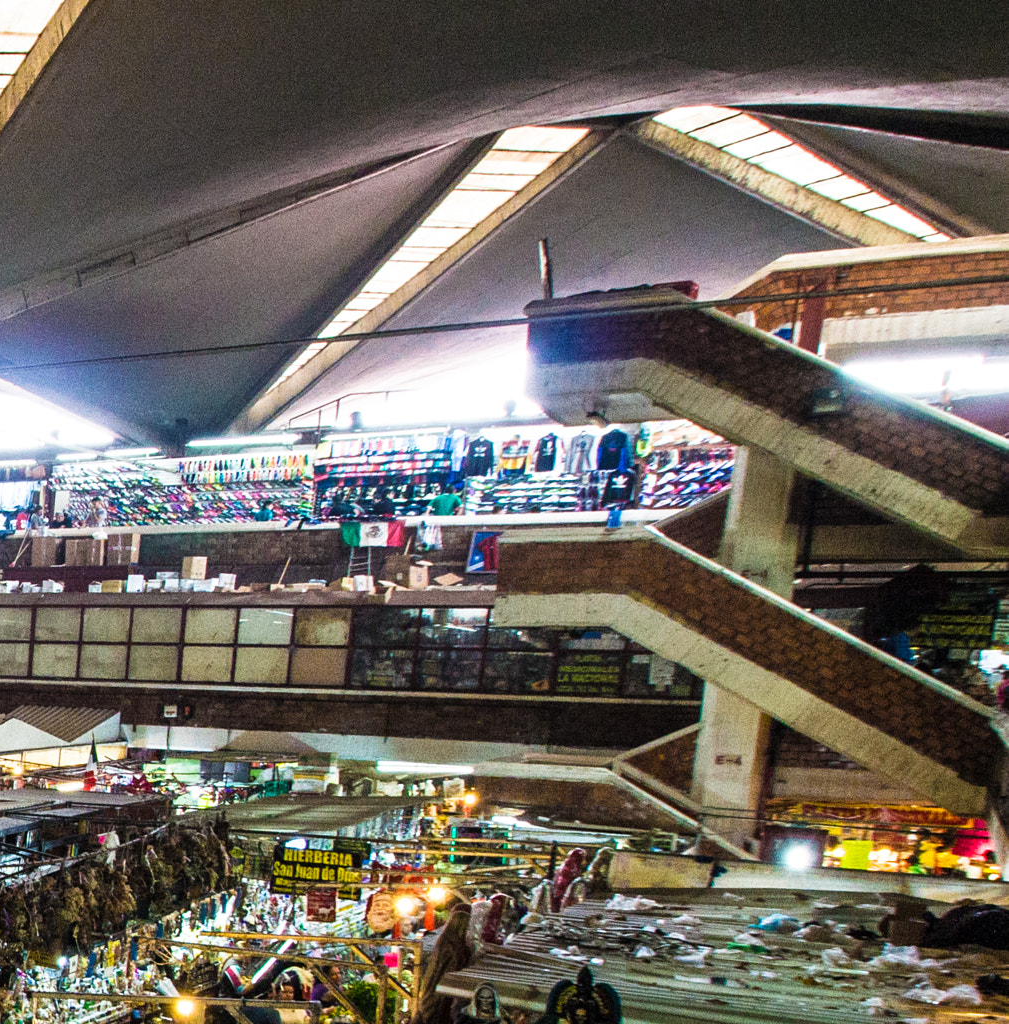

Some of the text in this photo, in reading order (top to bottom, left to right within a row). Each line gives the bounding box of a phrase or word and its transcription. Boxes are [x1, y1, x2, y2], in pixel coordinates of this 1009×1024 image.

[715, 754, 742, 765] E-4
[283, 848, 353, 867] HIERBERIA
[273, 861, 294, 878] San
[295, 863, 320, 880] Juan
[321, 866, 335, 881] de
